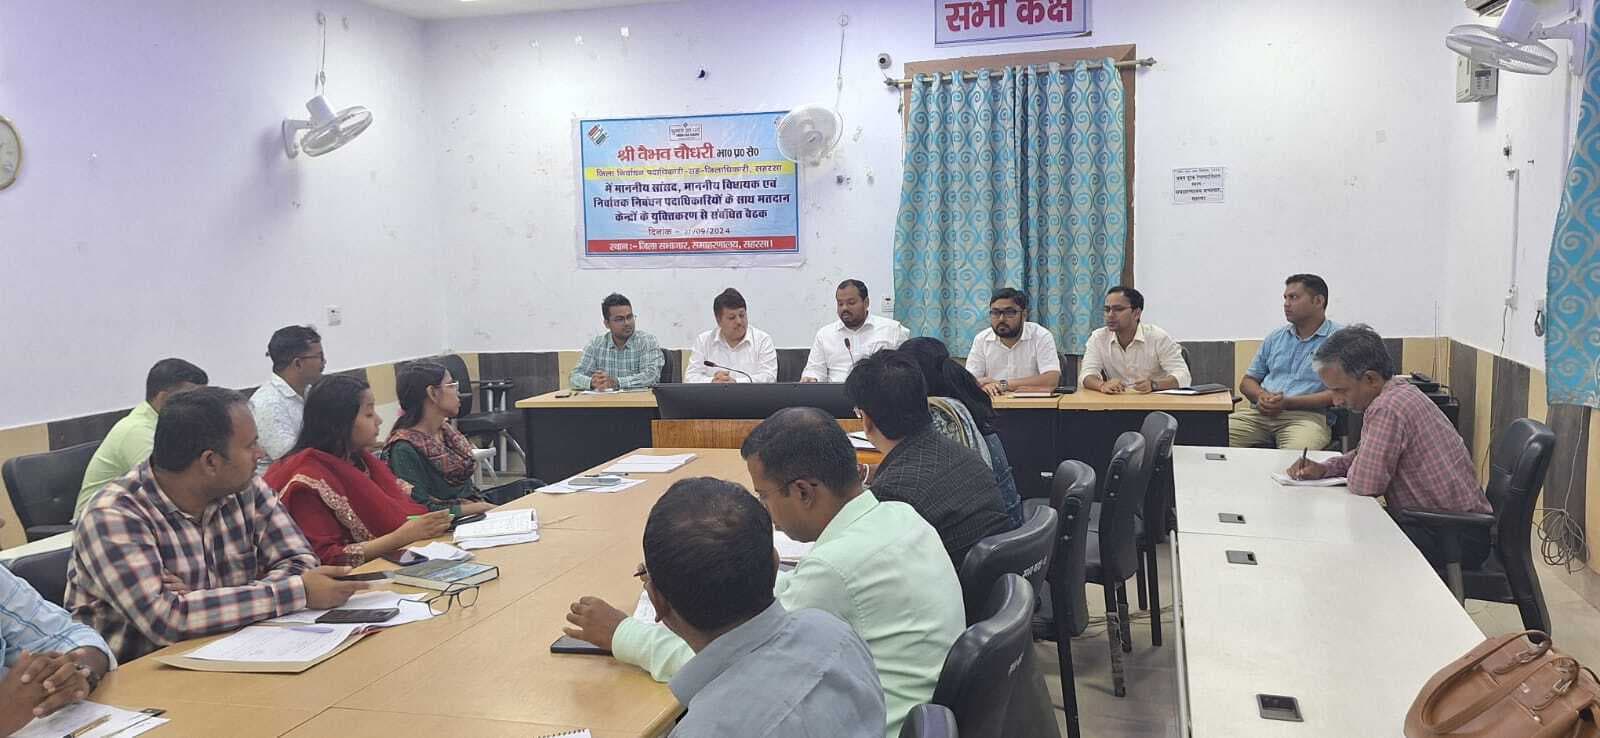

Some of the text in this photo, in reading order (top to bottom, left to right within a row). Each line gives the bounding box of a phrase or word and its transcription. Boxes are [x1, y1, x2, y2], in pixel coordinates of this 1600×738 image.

[617, 145, 634, 162] श्री
[638, 145, 671, 161] वैभव
[674, 142, 714, 160] चौधरी
[614, 182, 649, 192] माननीय
[684, 180, 720, 191] माननीय
[722, 178, 760, 190] विधायक
[725, 194, 734, 204] के
[757, 194, 790, 204] मतदान
